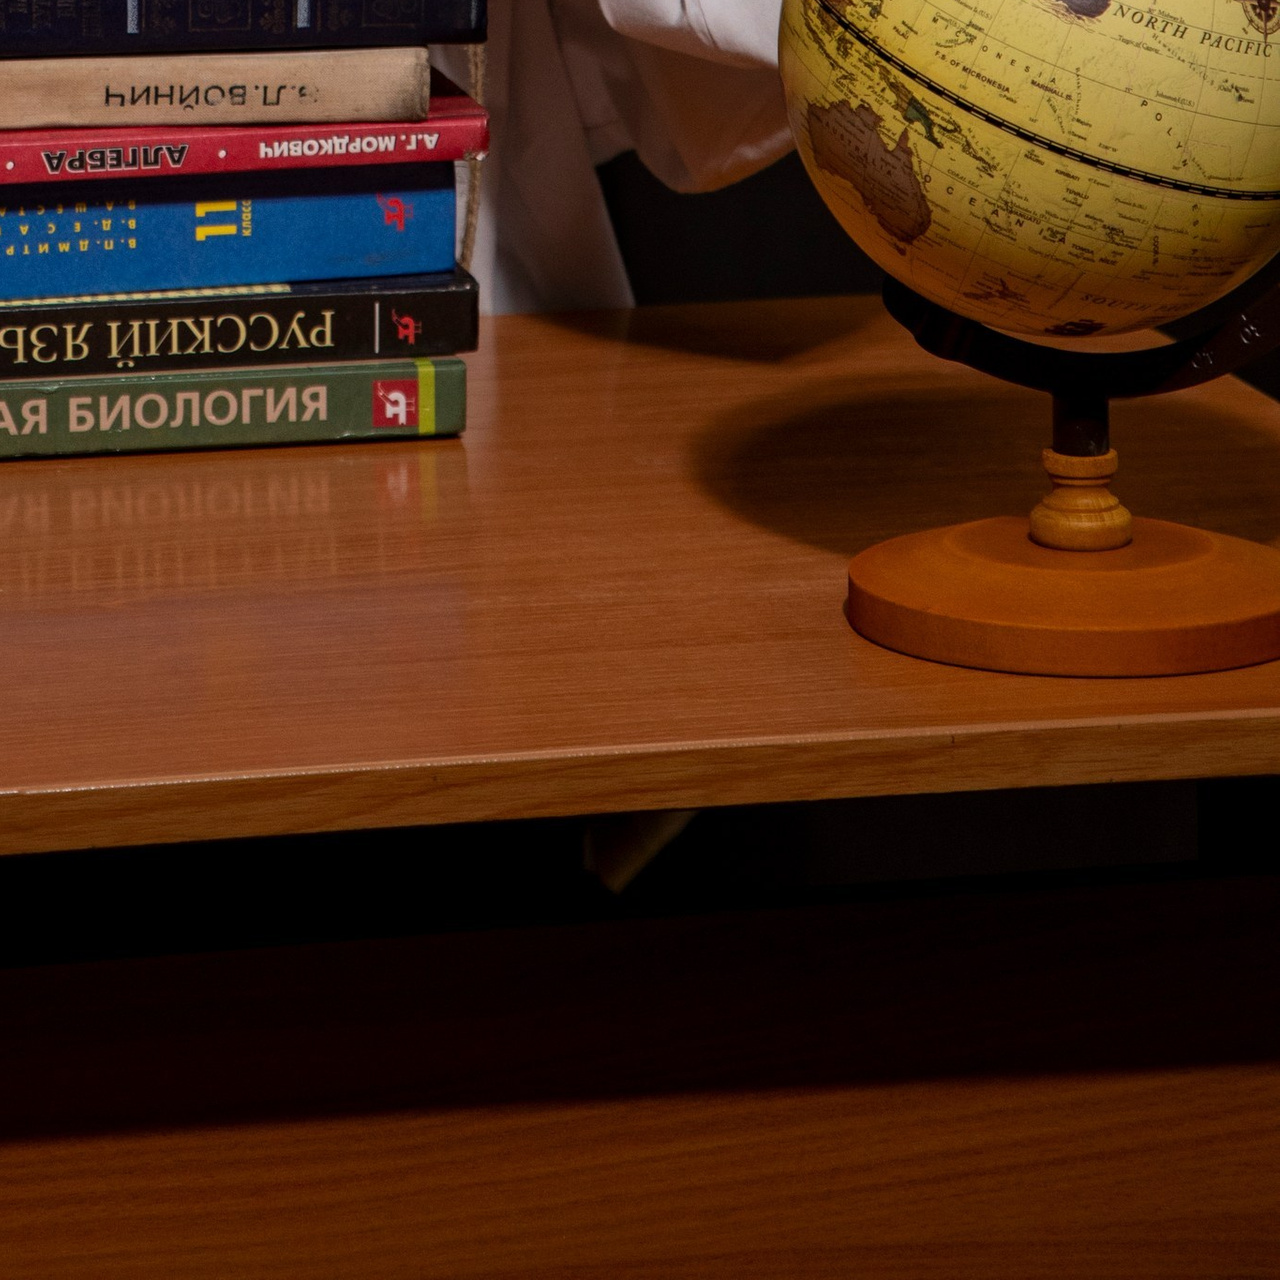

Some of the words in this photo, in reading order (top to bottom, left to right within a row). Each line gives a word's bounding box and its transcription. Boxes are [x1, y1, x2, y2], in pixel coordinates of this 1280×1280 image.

[1112, 4, 1189, 40] NORTH
[1199, 31, 1273, 58] PACIFIC
[949, 58, 961, 69] OF
[961, 65, 1011, 94] MICRONESIA
[103, 84, 247, 110] ВОЙНИЧ
[258, 134, 396, 159] МОРДКОВИЧ
[398, 131, 440, 151] А.Г.
[40, 143, 189, 175] АЛГЕБРА
[1065, 187, 1090, 200] TUVALU
[195, 200, 238, 241] 11
[106, 308, 335, 368] РУССКИЙ
[68, 384, 328, 433] БИОЛОГИЯ
